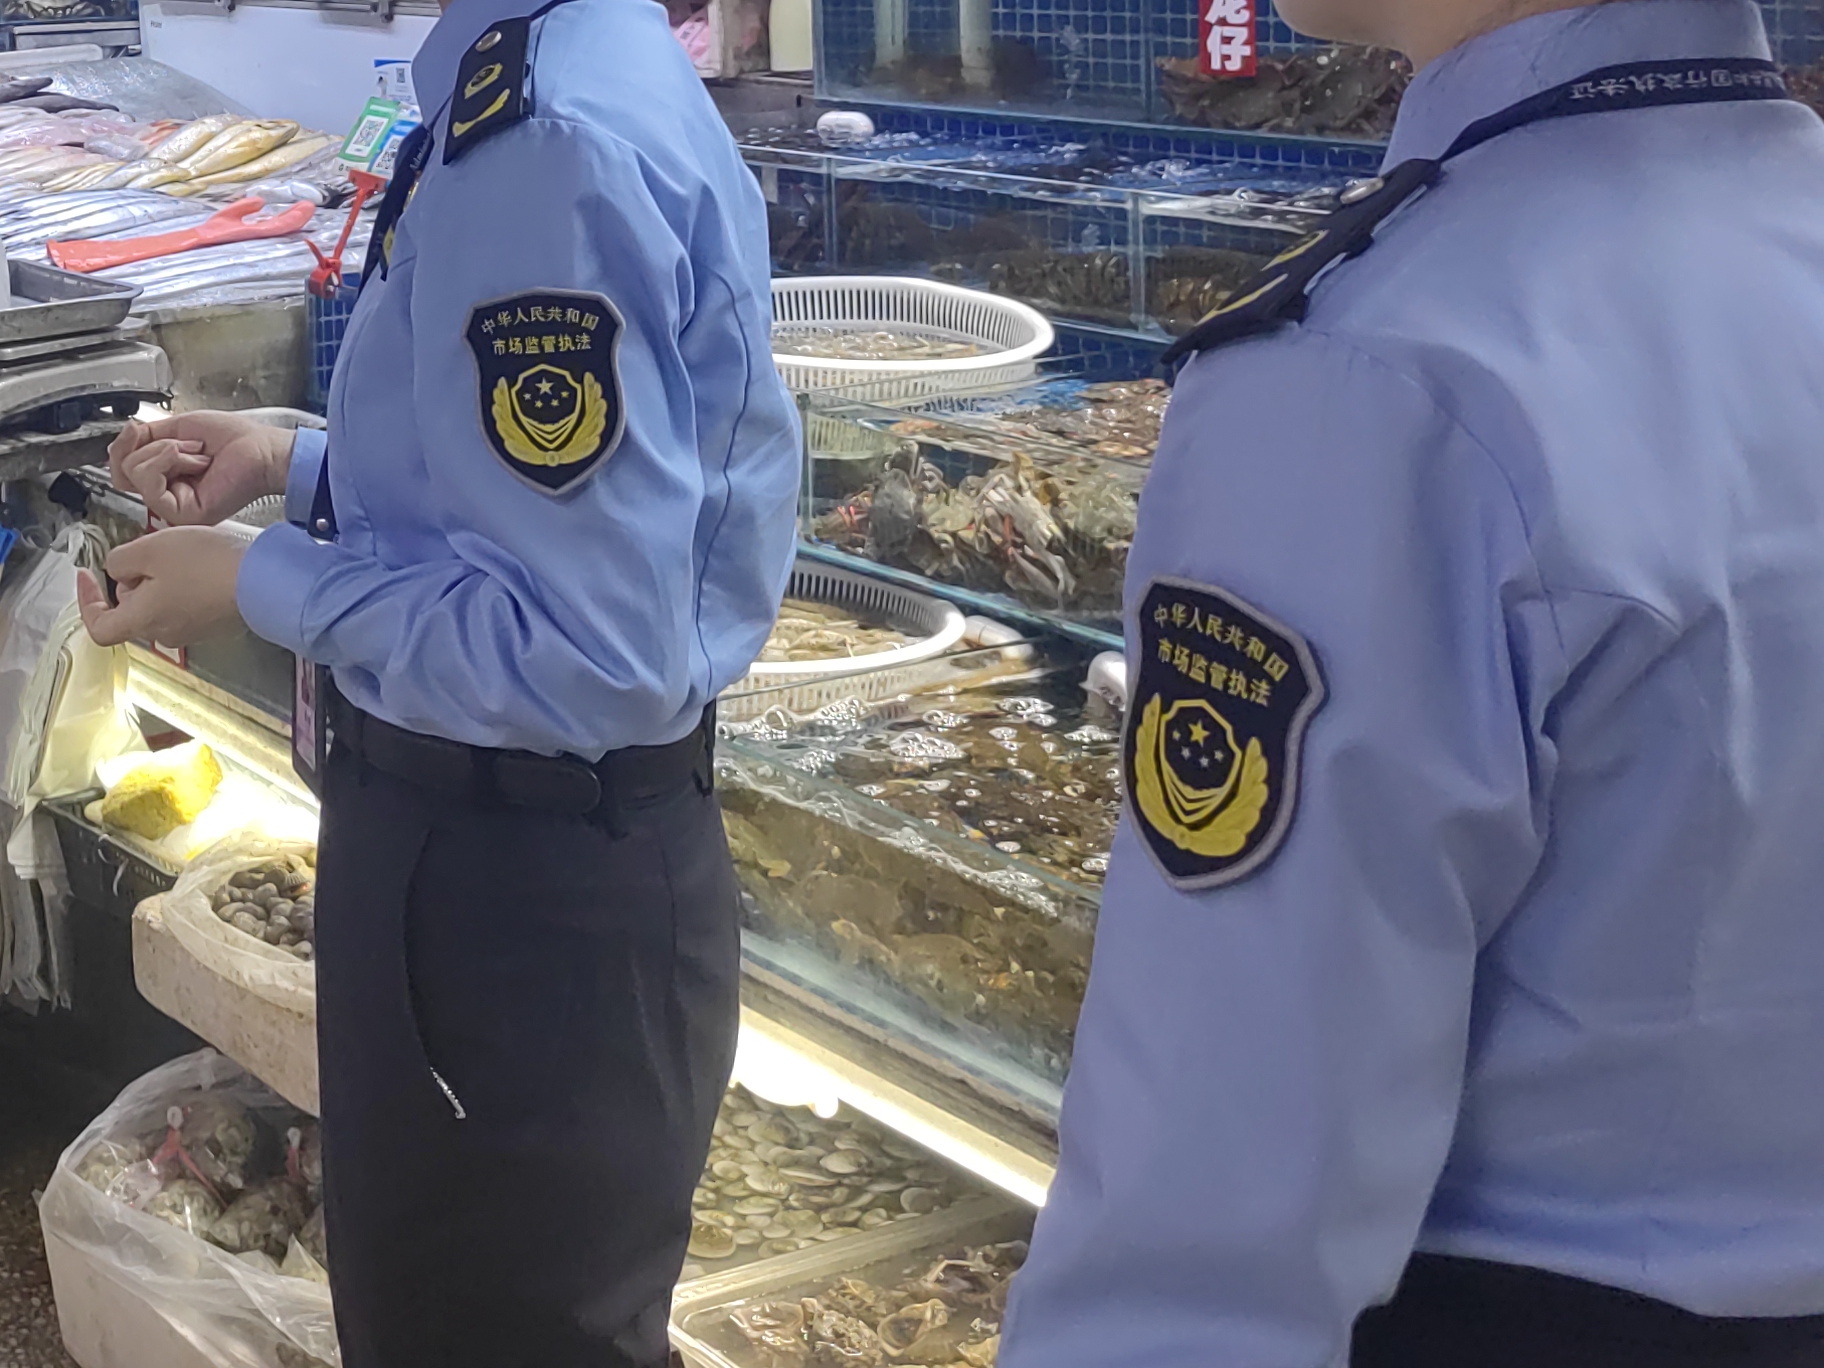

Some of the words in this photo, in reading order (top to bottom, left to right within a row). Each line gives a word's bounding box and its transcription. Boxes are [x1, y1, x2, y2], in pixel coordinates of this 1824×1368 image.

[480, 305, 600, 335] 中华人民共和国
[491, 332, 592, 356] 市场监管执法
[1153, 602, 1290, 682] 中华人民共和国
[1157, 637, 1273, 707] 市场监管执法
